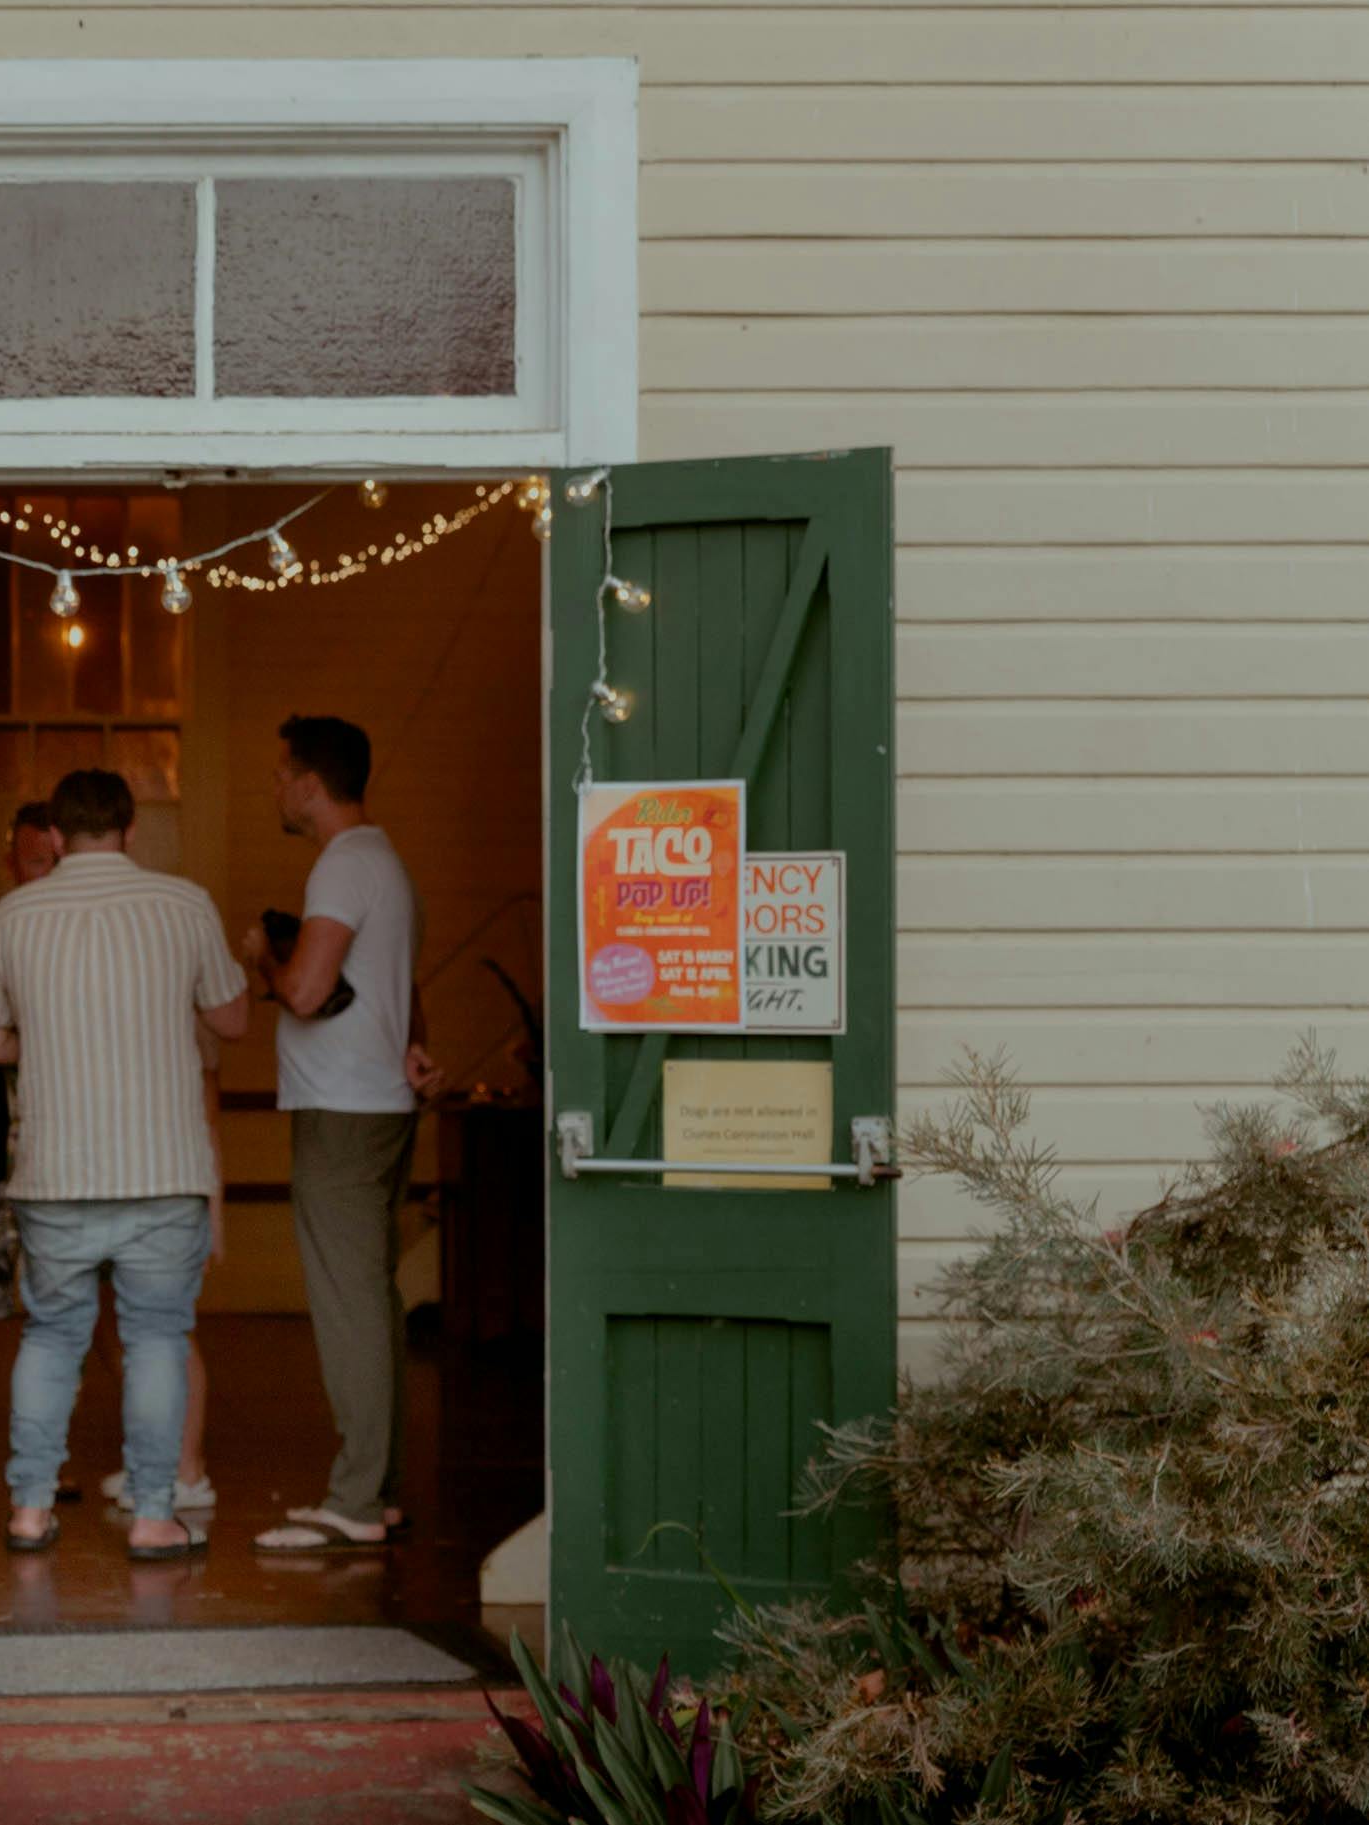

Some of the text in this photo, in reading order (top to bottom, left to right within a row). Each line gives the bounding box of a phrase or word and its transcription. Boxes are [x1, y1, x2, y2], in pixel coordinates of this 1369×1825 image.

[634, 797, 693, 824] Rider
[607, 826, 712, 877] TACO
[616, 880, 711, 910] POP UP!
[746, 988, 803, 1011] GHT.
[680, 1104, 709, 1119] Dogs
[712, 1107, 730, 1117] are
[757, 1104, 803, 1117] allowed
[791, 1128, 816, 1140] Hall
